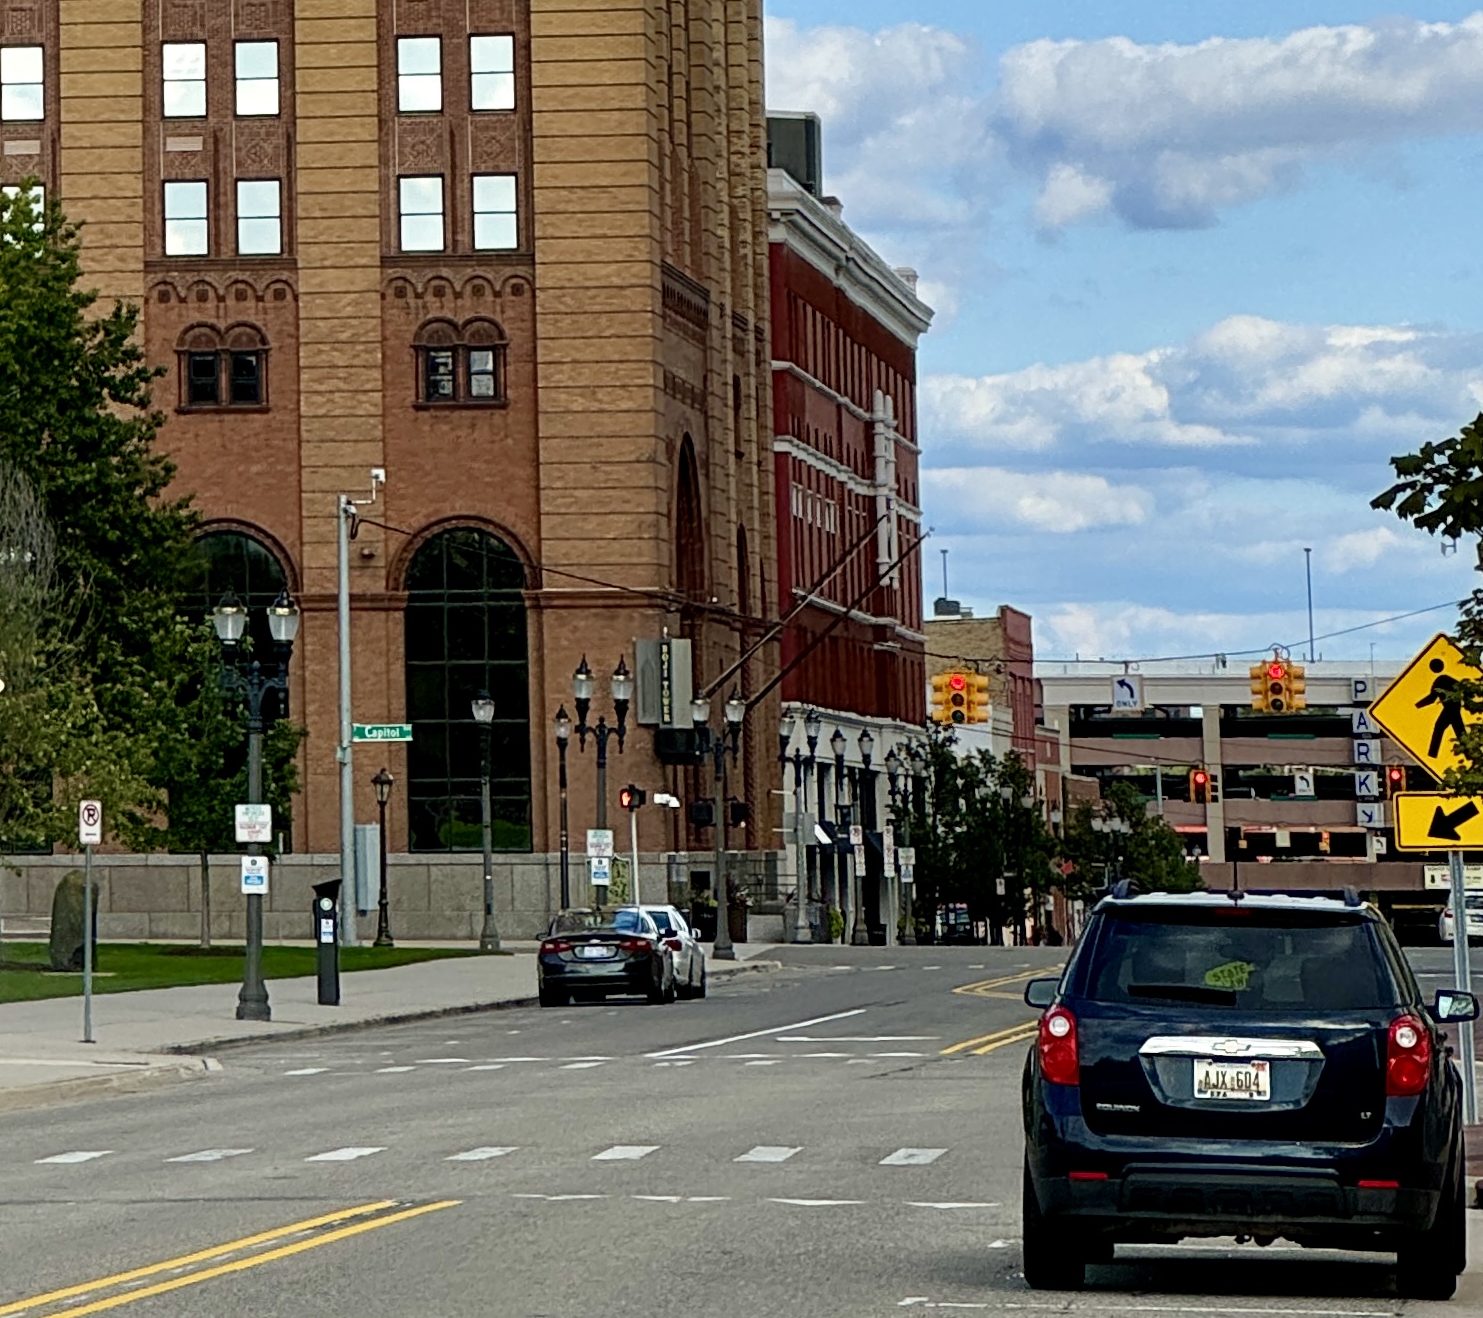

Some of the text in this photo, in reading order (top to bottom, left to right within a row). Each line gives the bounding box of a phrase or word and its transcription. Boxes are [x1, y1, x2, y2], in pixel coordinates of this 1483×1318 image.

[662, 681, 671, 722] TOWER
[1116, 700, 1138, 708] ONLY
[364, 725, 400, 739] Capitol
[1212, 963, 1246, 982] STATE
[1204, 1070, 1260, 1091] AJX 604
[1360, 1111, 1372, 1120] LT
